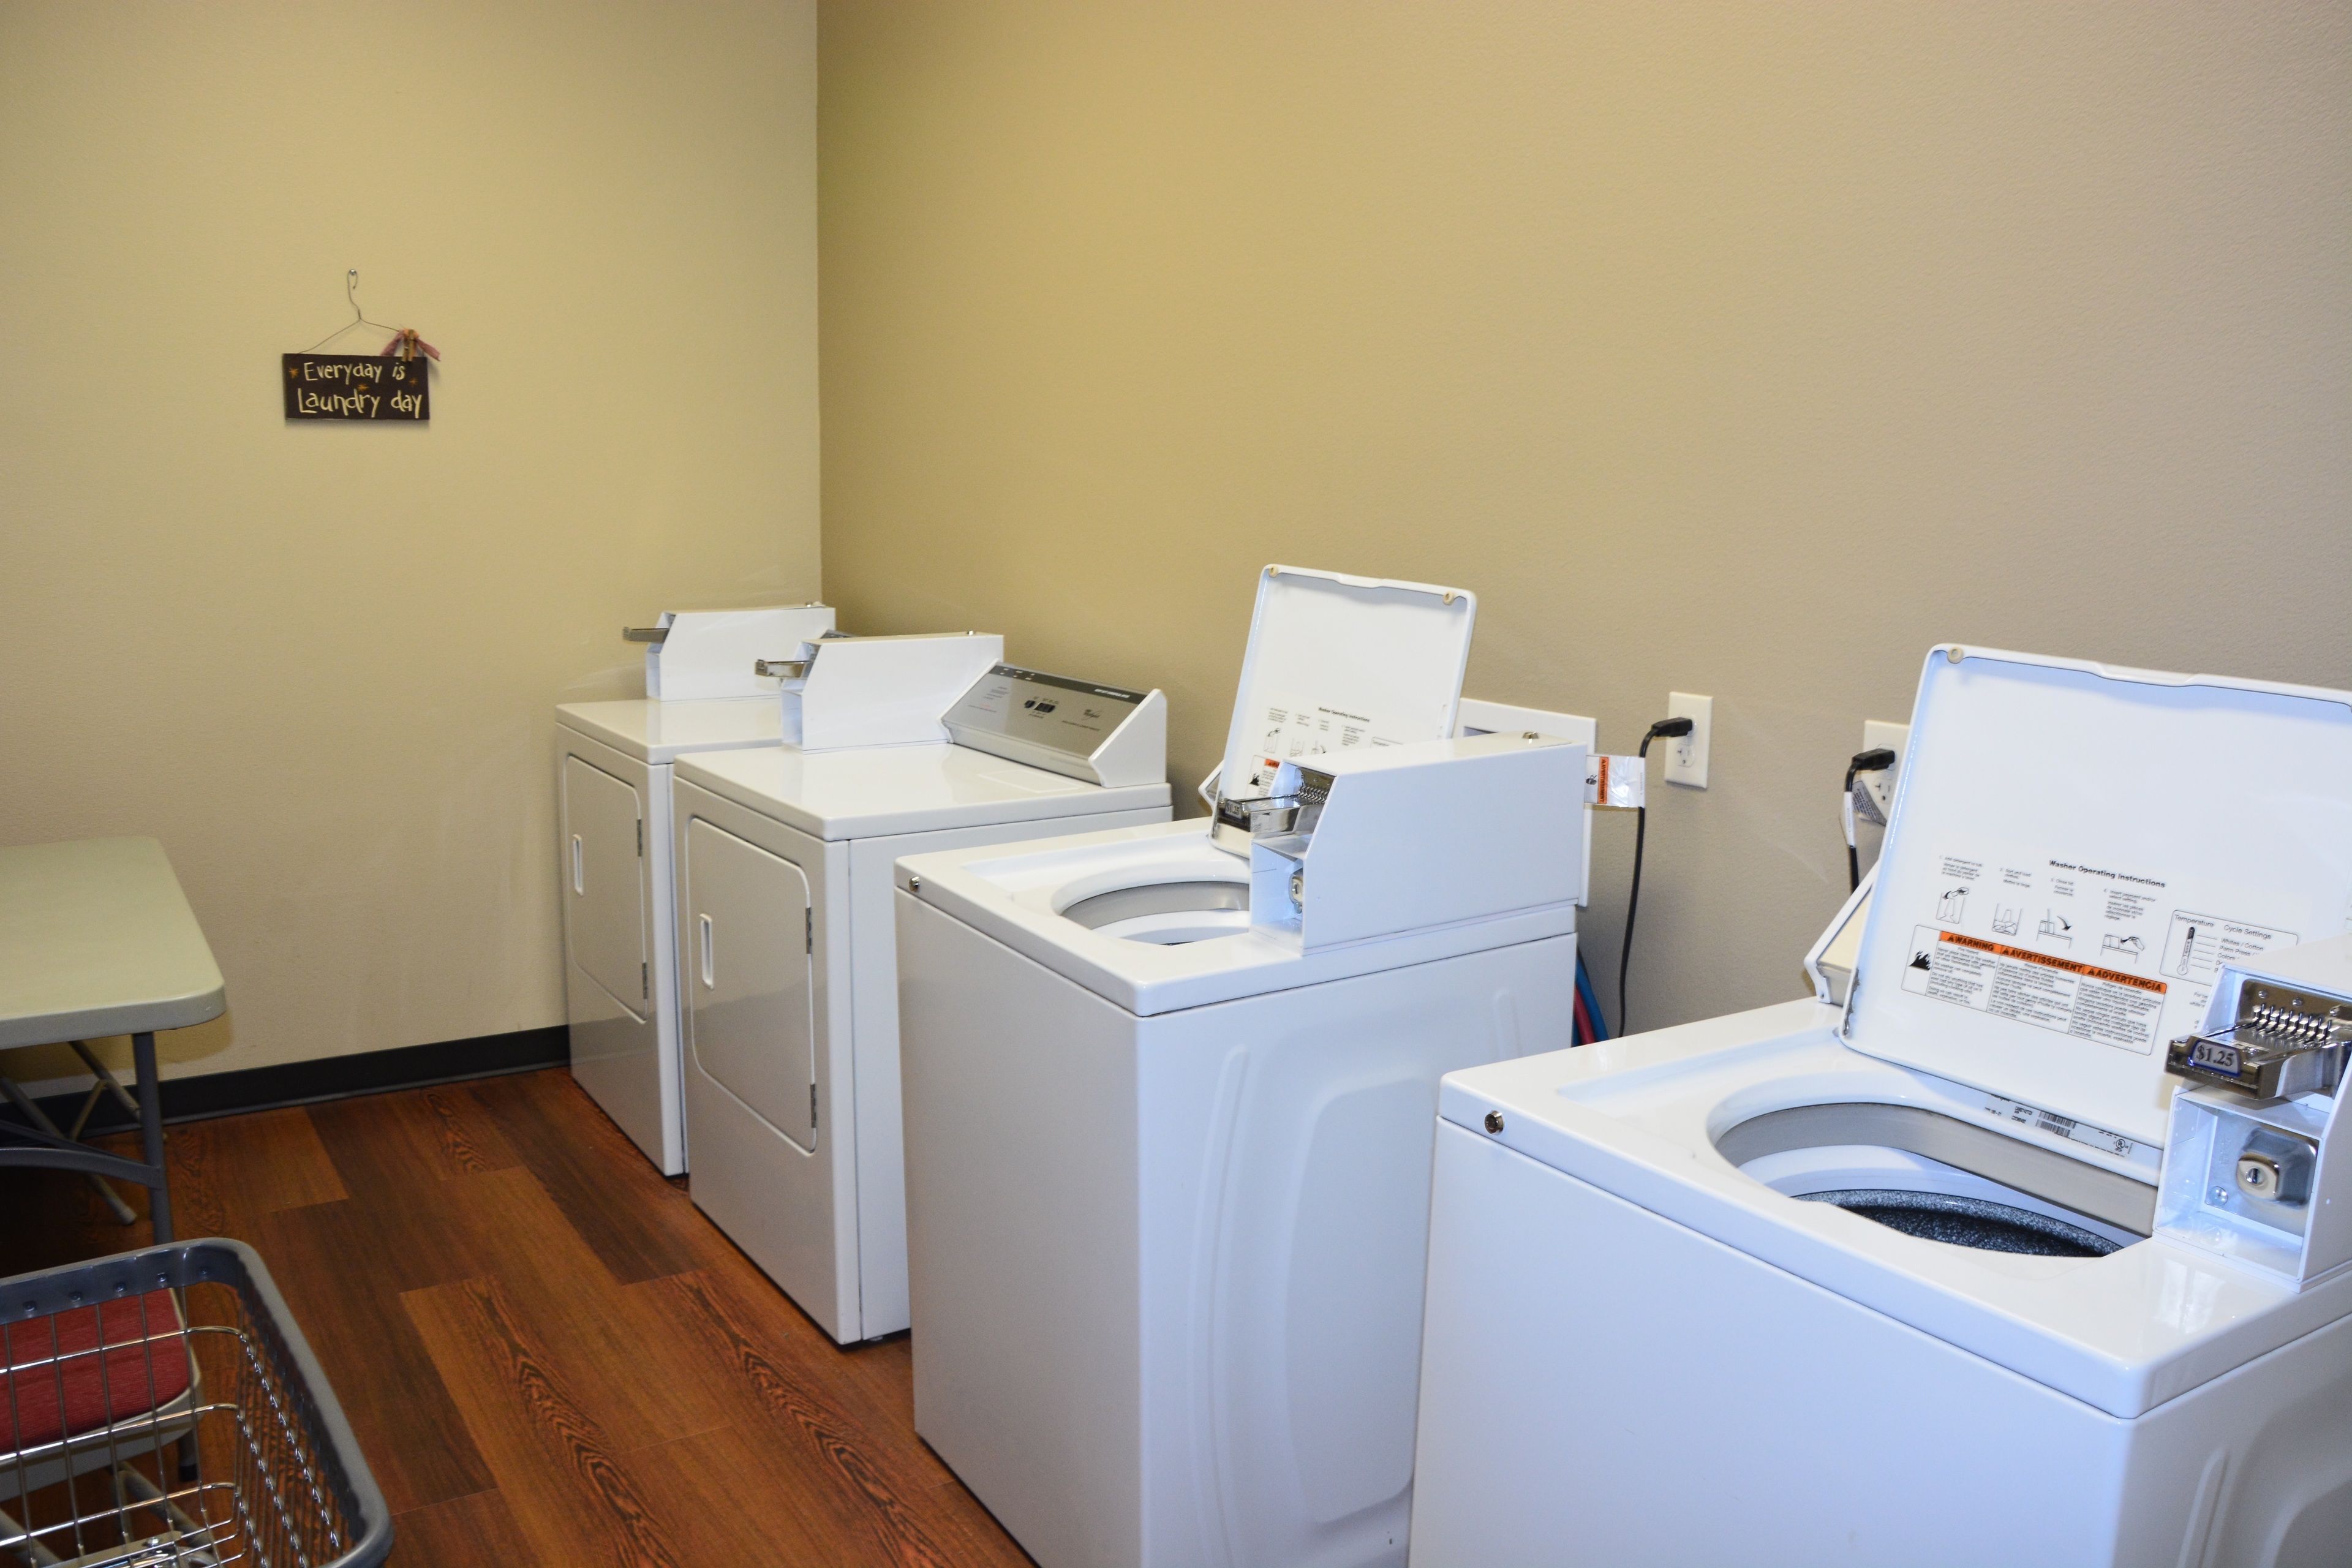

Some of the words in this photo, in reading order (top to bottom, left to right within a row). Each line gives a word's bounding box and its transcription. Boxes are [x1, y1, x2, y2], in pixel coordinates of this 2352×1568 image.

[304, 362, 382, 385] Everyday
[392, 363, 406, 380] is
[298, 388, 381, 418] Laundry
[391, 390, 423, 419] day
[2049, 859, 2076, 871] Washer
[2078, 865, 2116, 880] Operating
[2117, 873, 2166, 888] Instructions
[2174, 914, 2214, 928] Temperature
[2224, 924, 2242, 935] Cycle
[2244, 929, 2271, 940] Settings
[1955, 935, 1994, 951] WARNING
[2221, 938, 2239, 946] Whites
[2244, 943, 2264, 951] Cotton
[2235, 948, 2251, 957] Press
[2010, 949, 2082, 973] AVERTISSEMENT
[2217, 952, 2235, 961] Colors
[2095, 970, 2161, 992] ADVERTENCIA
[2196, 1045, 2234, 1067] $1.25
